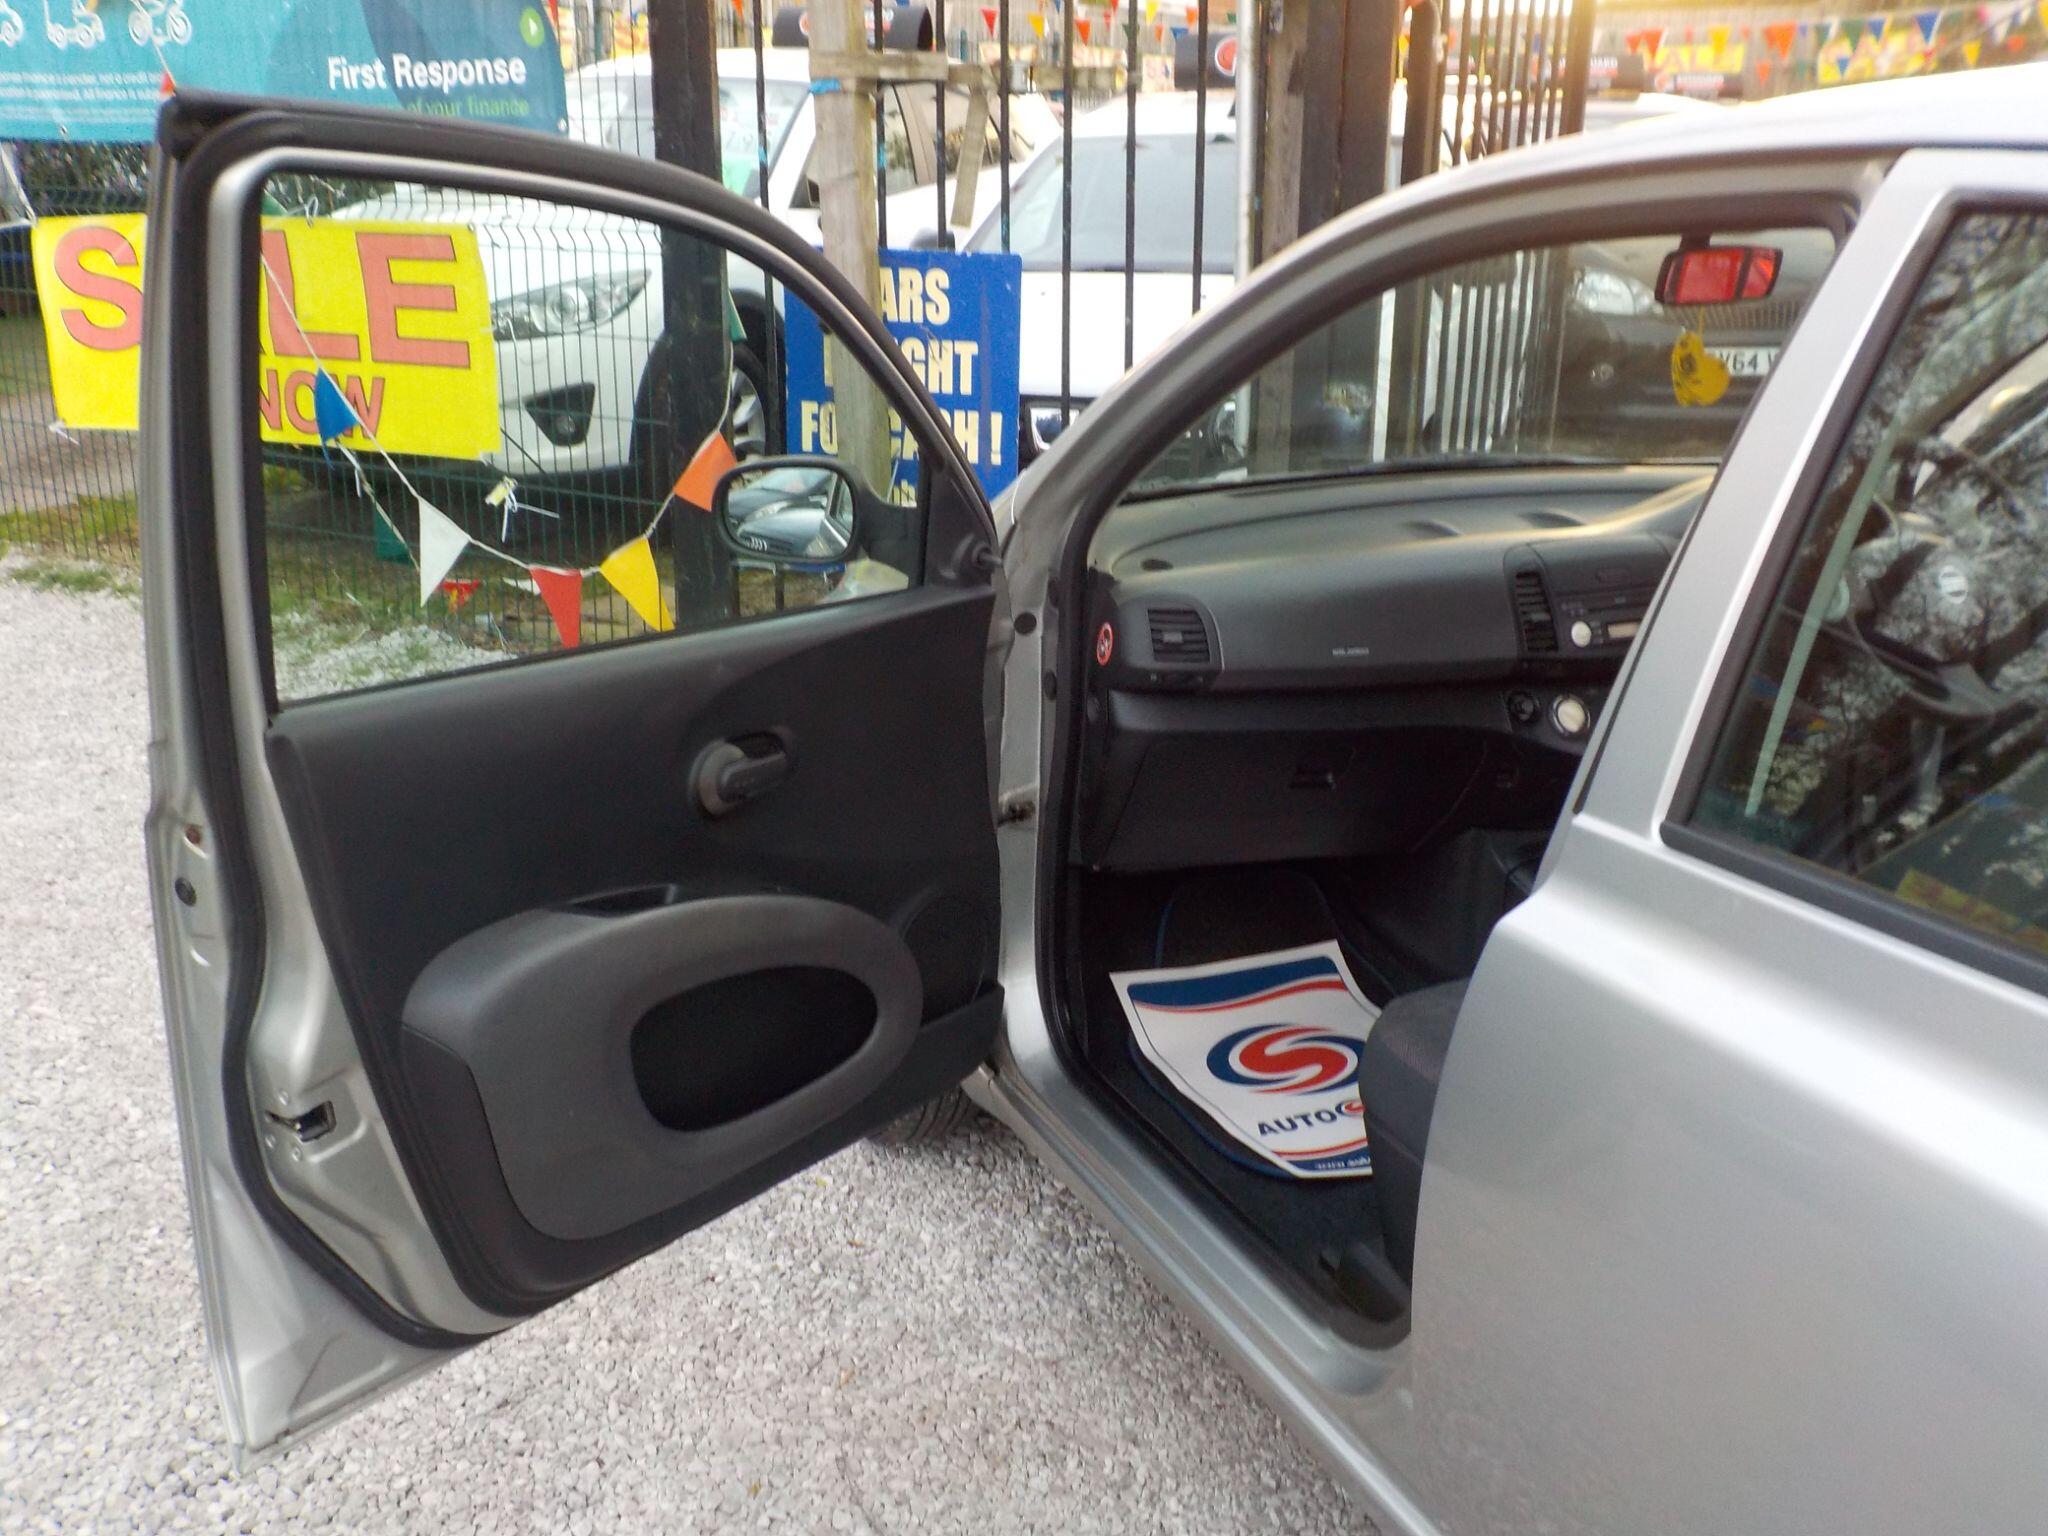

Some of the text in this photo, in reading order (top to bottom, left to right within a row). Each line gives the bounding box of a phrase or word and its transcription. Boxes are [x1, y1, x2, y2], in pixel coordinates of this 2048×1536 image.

[328, 53, 527, 94] First Response
[467, 95, 530, 117] finance
[54, 226, 470, 368] SLE
[879, 266, 951, 326] ARS
[800, 400, 839, 455] FO
